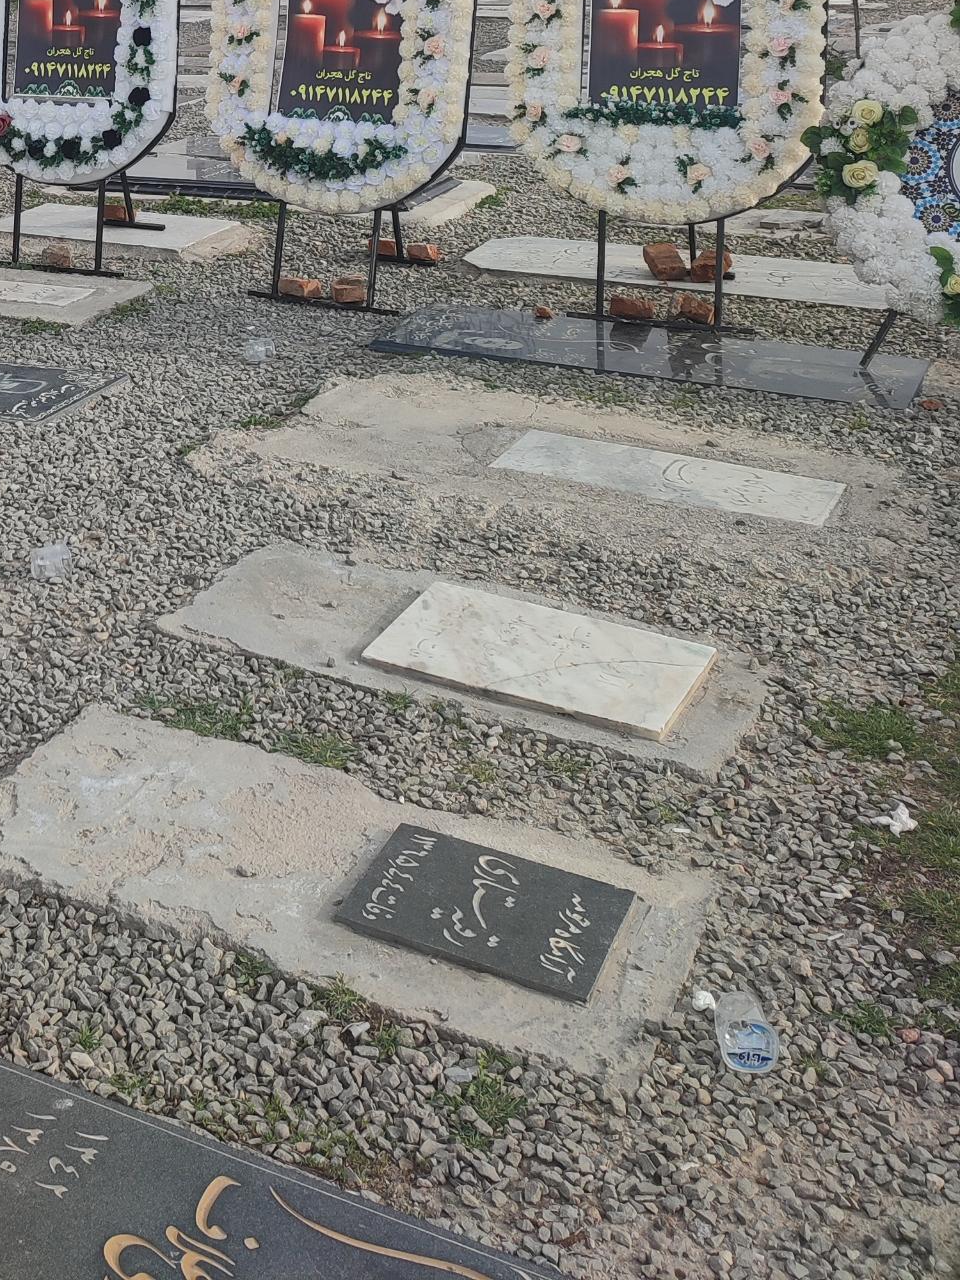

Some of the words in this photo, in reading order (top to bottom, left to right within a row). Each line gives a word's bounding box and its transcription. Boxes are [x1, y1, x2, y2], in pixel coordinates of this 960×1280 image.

[47, 47, 71, 57] هجران
[73, 47, 83, 57] گل
[84, 49, 95, 59] تاج
[316, 69, 342, 80] هجران
[345, 69, 356, 81] گل
[357, 72, 371, 83] تاج
[630, 68, 663, 79] هجران
[666, 68, 681, 80] گل
[684, 69, 700, 81] تاج
[362, 887, 396, 920] وفات
[430, 906, 501, 947] رقیه
[472, 855, 520, 930] ستاری
[559, 893, 590, 934] مرحومه
[540, 928, 585, 984] آرامگاه
